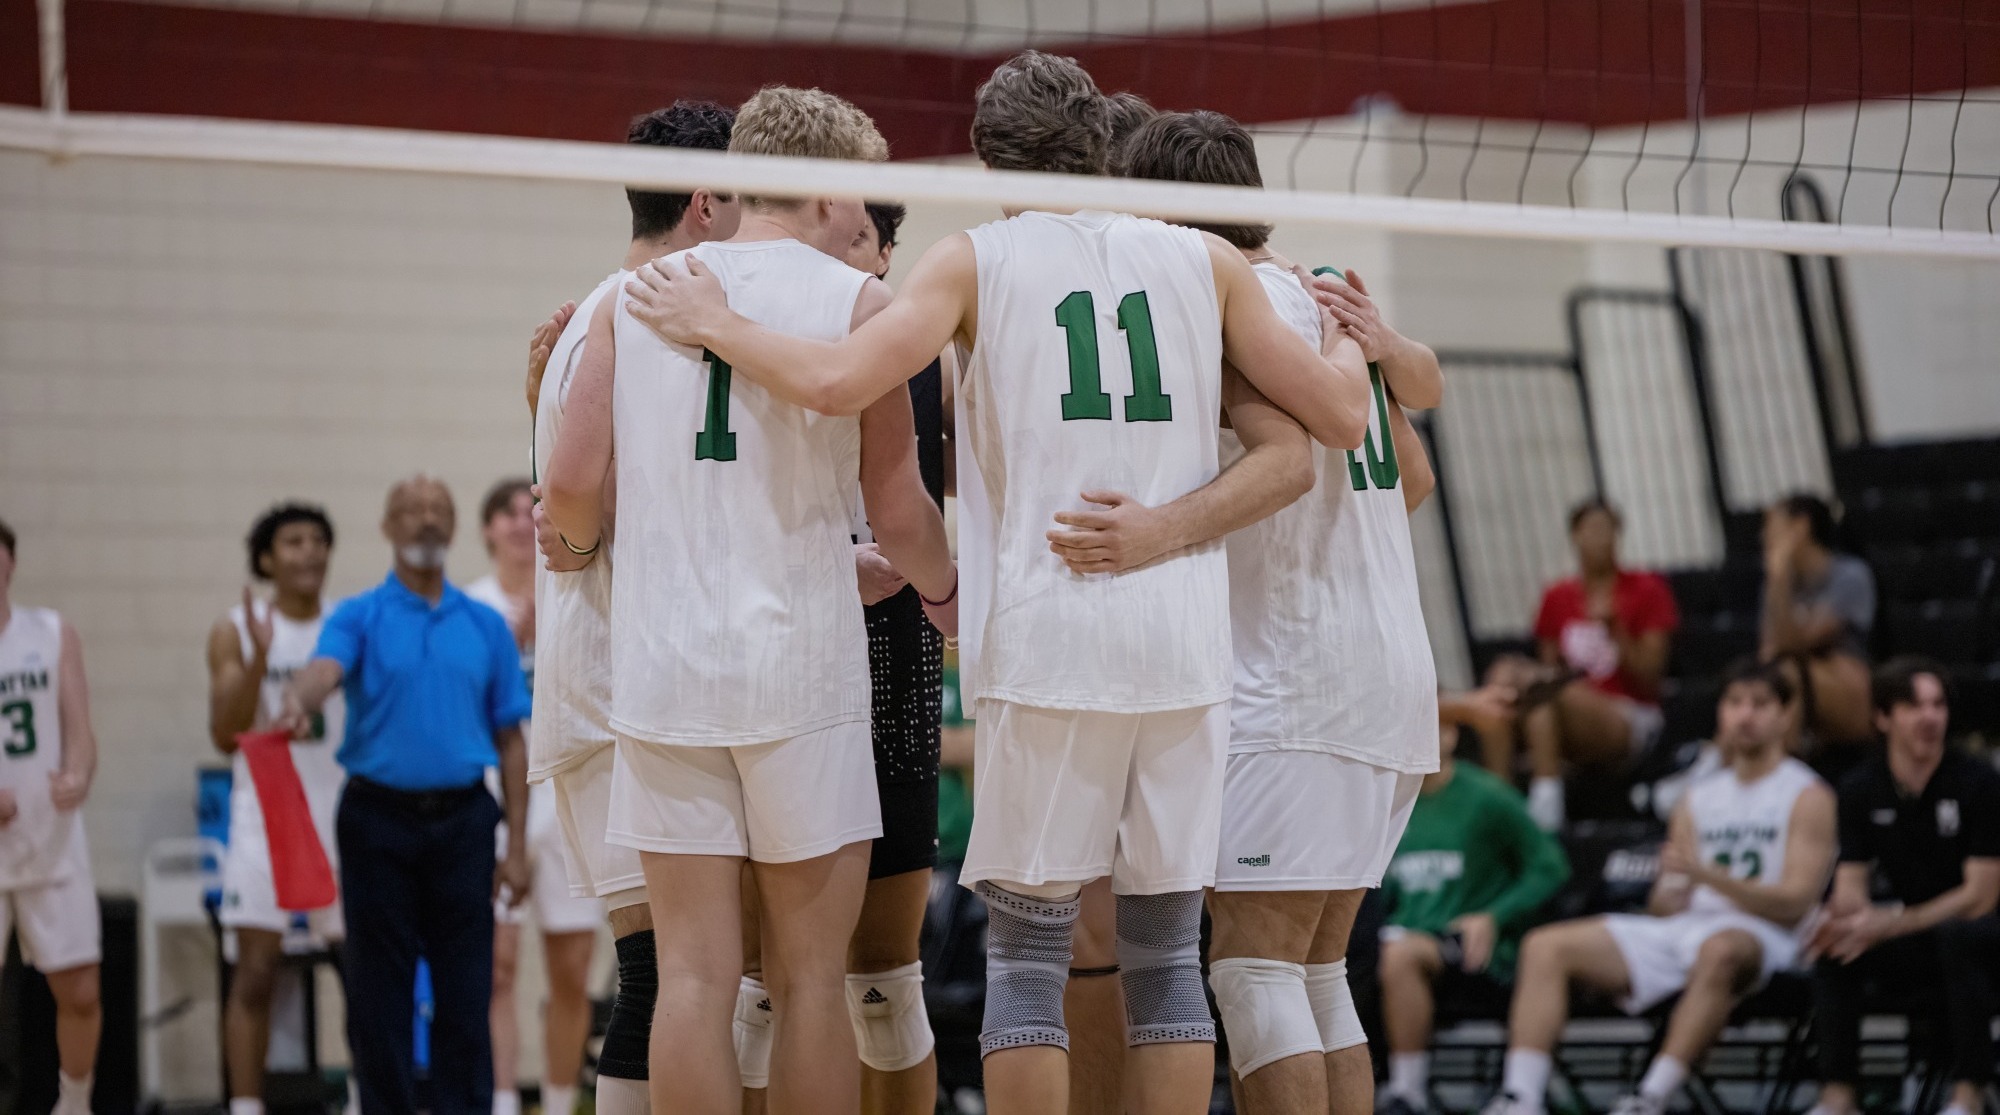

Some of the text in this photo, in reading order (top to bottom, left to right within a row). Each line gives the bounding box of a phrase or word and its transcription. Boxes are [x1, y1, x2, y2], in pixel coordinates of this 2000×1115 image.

[695, 346, 737, 461] 1
[1055, 290, 1172, 422] 11
[1237, 854, 1271, 867] capelli
